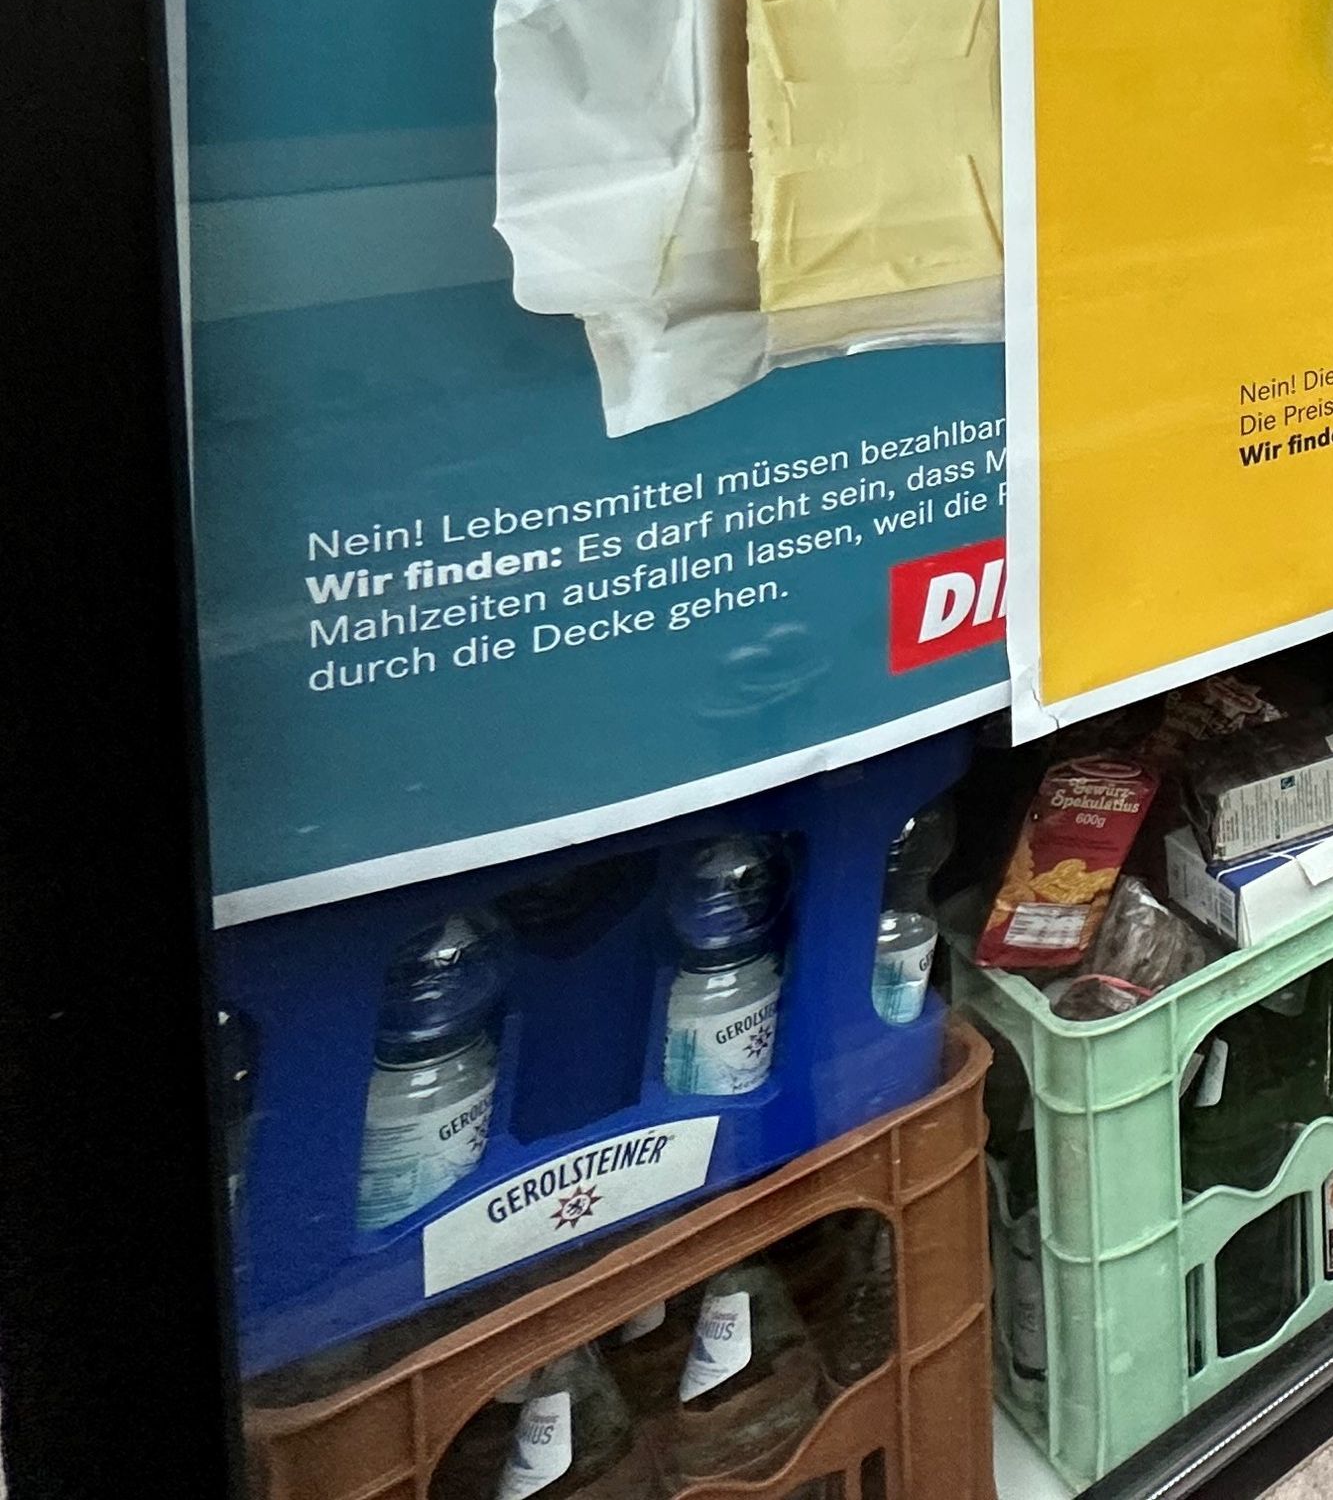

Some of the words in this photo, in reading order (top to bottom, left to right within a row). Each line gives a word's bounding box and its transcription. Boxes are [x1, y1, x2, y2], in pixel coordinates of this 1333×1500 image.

[1240, 375, 1296, 405] Nein!
[1240, 412, 1276, 436] Die
[1239, 440, 1283, 467] Wir
[308, 518, 424, 561] Nein!
[443, 473, 703, 543] Lebensmittel
[717, 451, 848, 496] müssen
[861, 418, 1006, 465] bezahlbar
[305, 569, 393, 605] Wir
[404, 546, 563, 591] finden:
[578, 532, 622, 563] Es
[636, 512, 713, 551] darf
[725, 493, 810, 534] nicht
[821, 478, 896, 512] sein,
[907, 459, 975, 492] dass
[310, 591, 546, 648] Mahlzeiten
[562, 553, 733, 606] ausfallen
[748, 524, 863, 567] lassen,
[874, 494, 933, 536] weil
[944, 490, 988, 518] die
[918, 558, 1007, 644] DI
[308, 647, 436, 692] durch
[453, 634, 516, 668] die
[533, 609, 655, 653] Decke
[668, 580, 789, 631] gehen.
[1050, 788, 1141, 814] Spekulatius
[1068, 777, 1137, 799] Gewürz-
[1075, 812, 1106, 829] 600g
[487, 1130, 670, 1224] GEROLSTEINER
